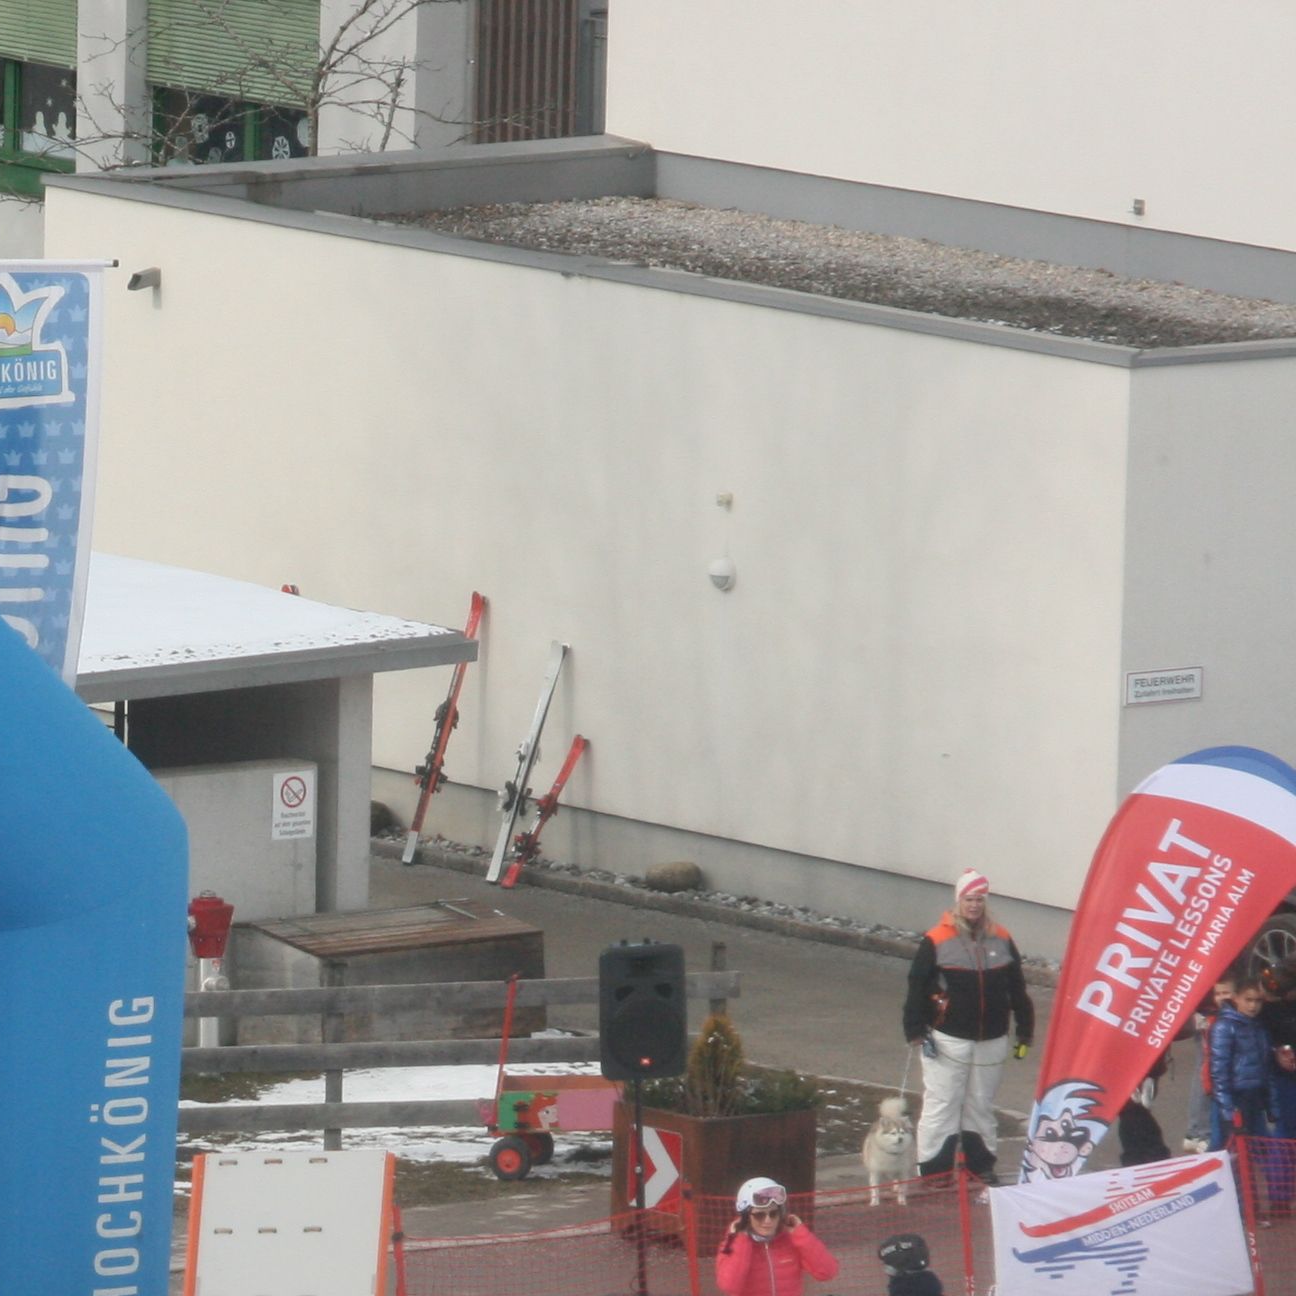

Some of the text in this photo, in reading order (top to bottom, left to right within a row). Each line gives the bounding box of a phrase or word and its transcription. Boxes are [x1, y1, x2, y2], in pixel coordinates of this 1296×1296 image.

[1134, 674, 1195, 688] FEUERWEHR
[1076, 818, 1211, 1028] PRIVAT
[1123, 854, 1233, 1038] PRIVATE LESSONS
[1148, 868, 1256, 1049] SKISCHULE MARIA ALM
[1110, 1187, 1156, 1215] SKITEAM
